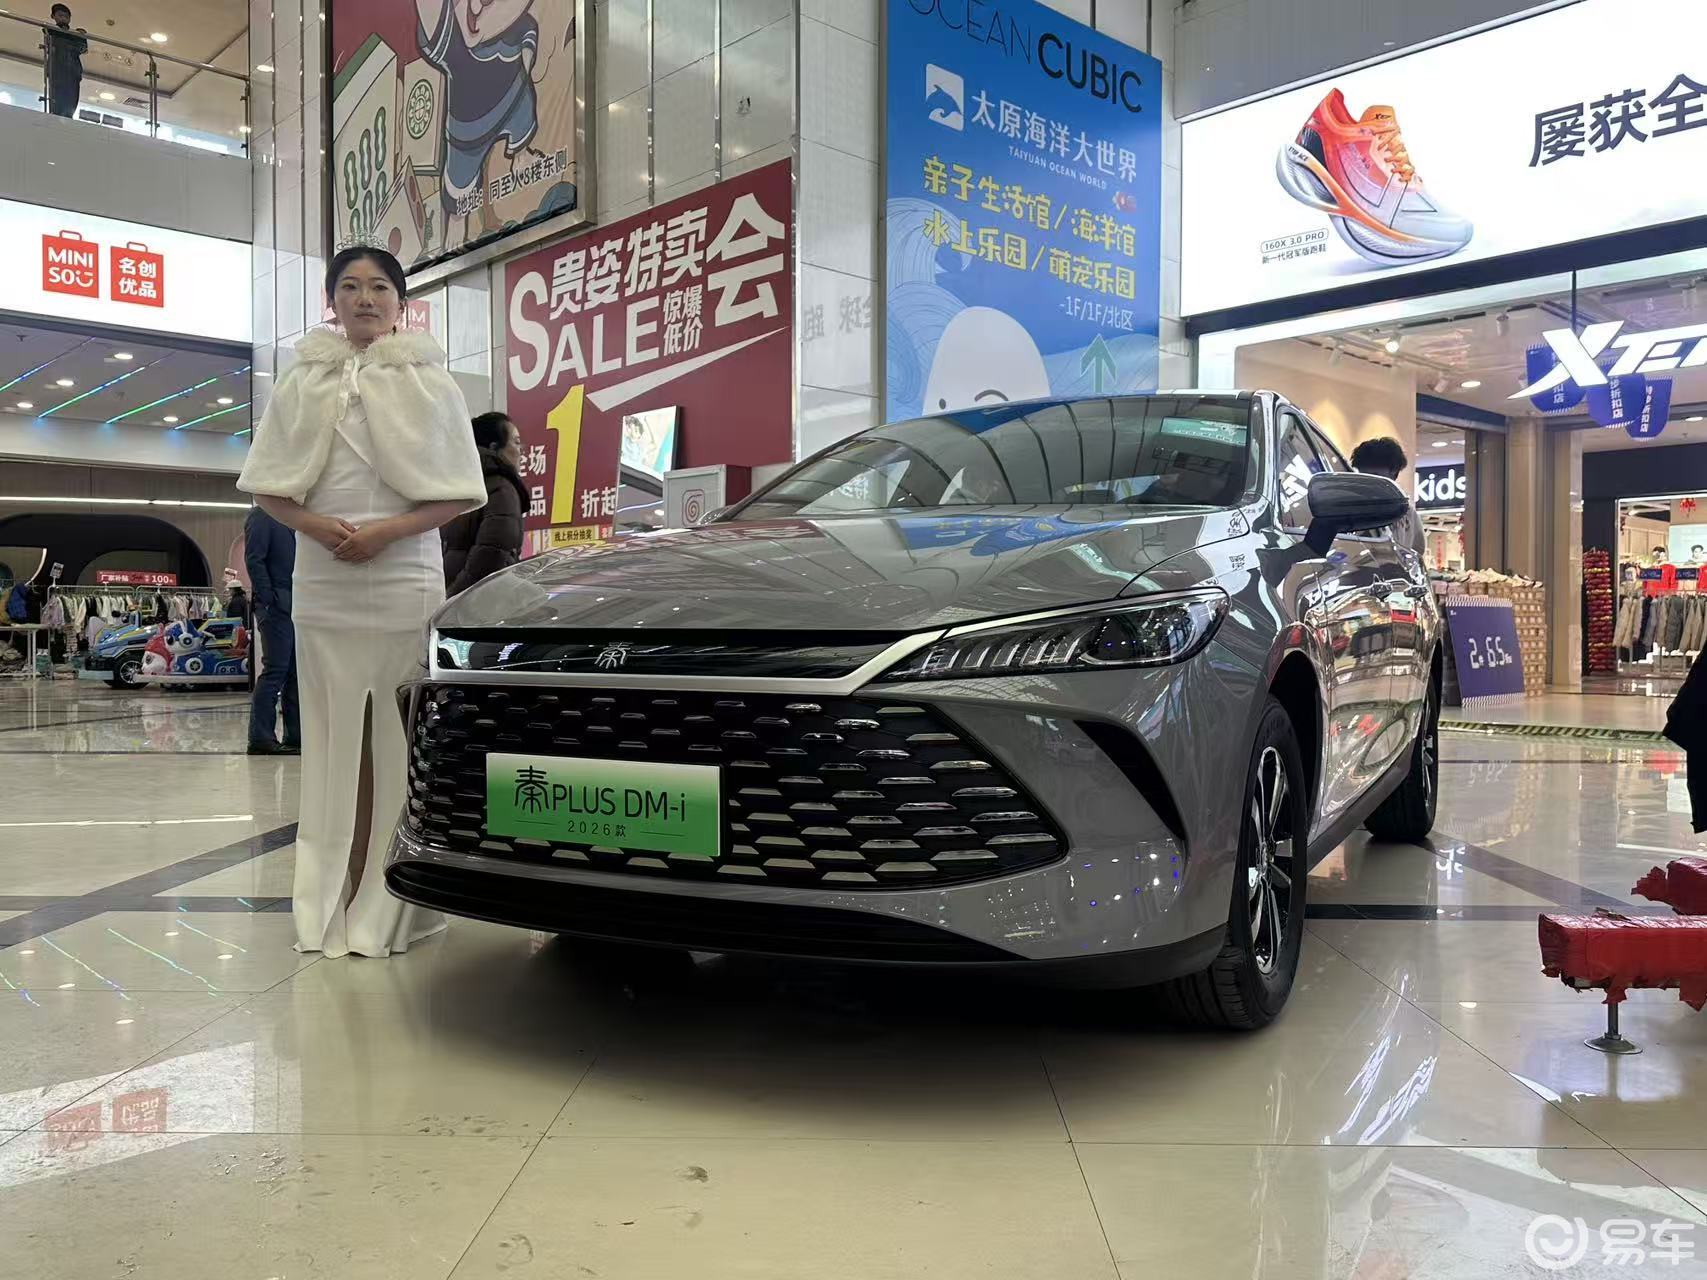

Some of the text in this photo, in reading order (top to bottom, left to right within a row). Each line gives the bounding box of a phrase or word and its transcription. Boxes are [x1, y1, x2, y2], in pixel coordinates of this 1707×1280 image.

[971, 90, 1137, 184] 太原海洋大世界
[1528, 73, 1707, 167] 屡获全
[1008, 145, 1107, 190] TAIYUAN OCEAN WORLD
[1305, 231, 1325, 242] PRO
[47, 246, 94, 269] MINI
[118, 256, 157, 279] 名创
[549, 192, 786, 327] 贵姿特卖会
[118, 276, 157, 299] 优品
[663, 285, 703, 325] 惊爆
[509, 271, 660, 391] SALE
[663, 318, 703, 356] 低价
[1414, 468, 1466, 502] kids
[624, 789, 687, 823] DM-i
[567, 819, 627, 838] 2026款
